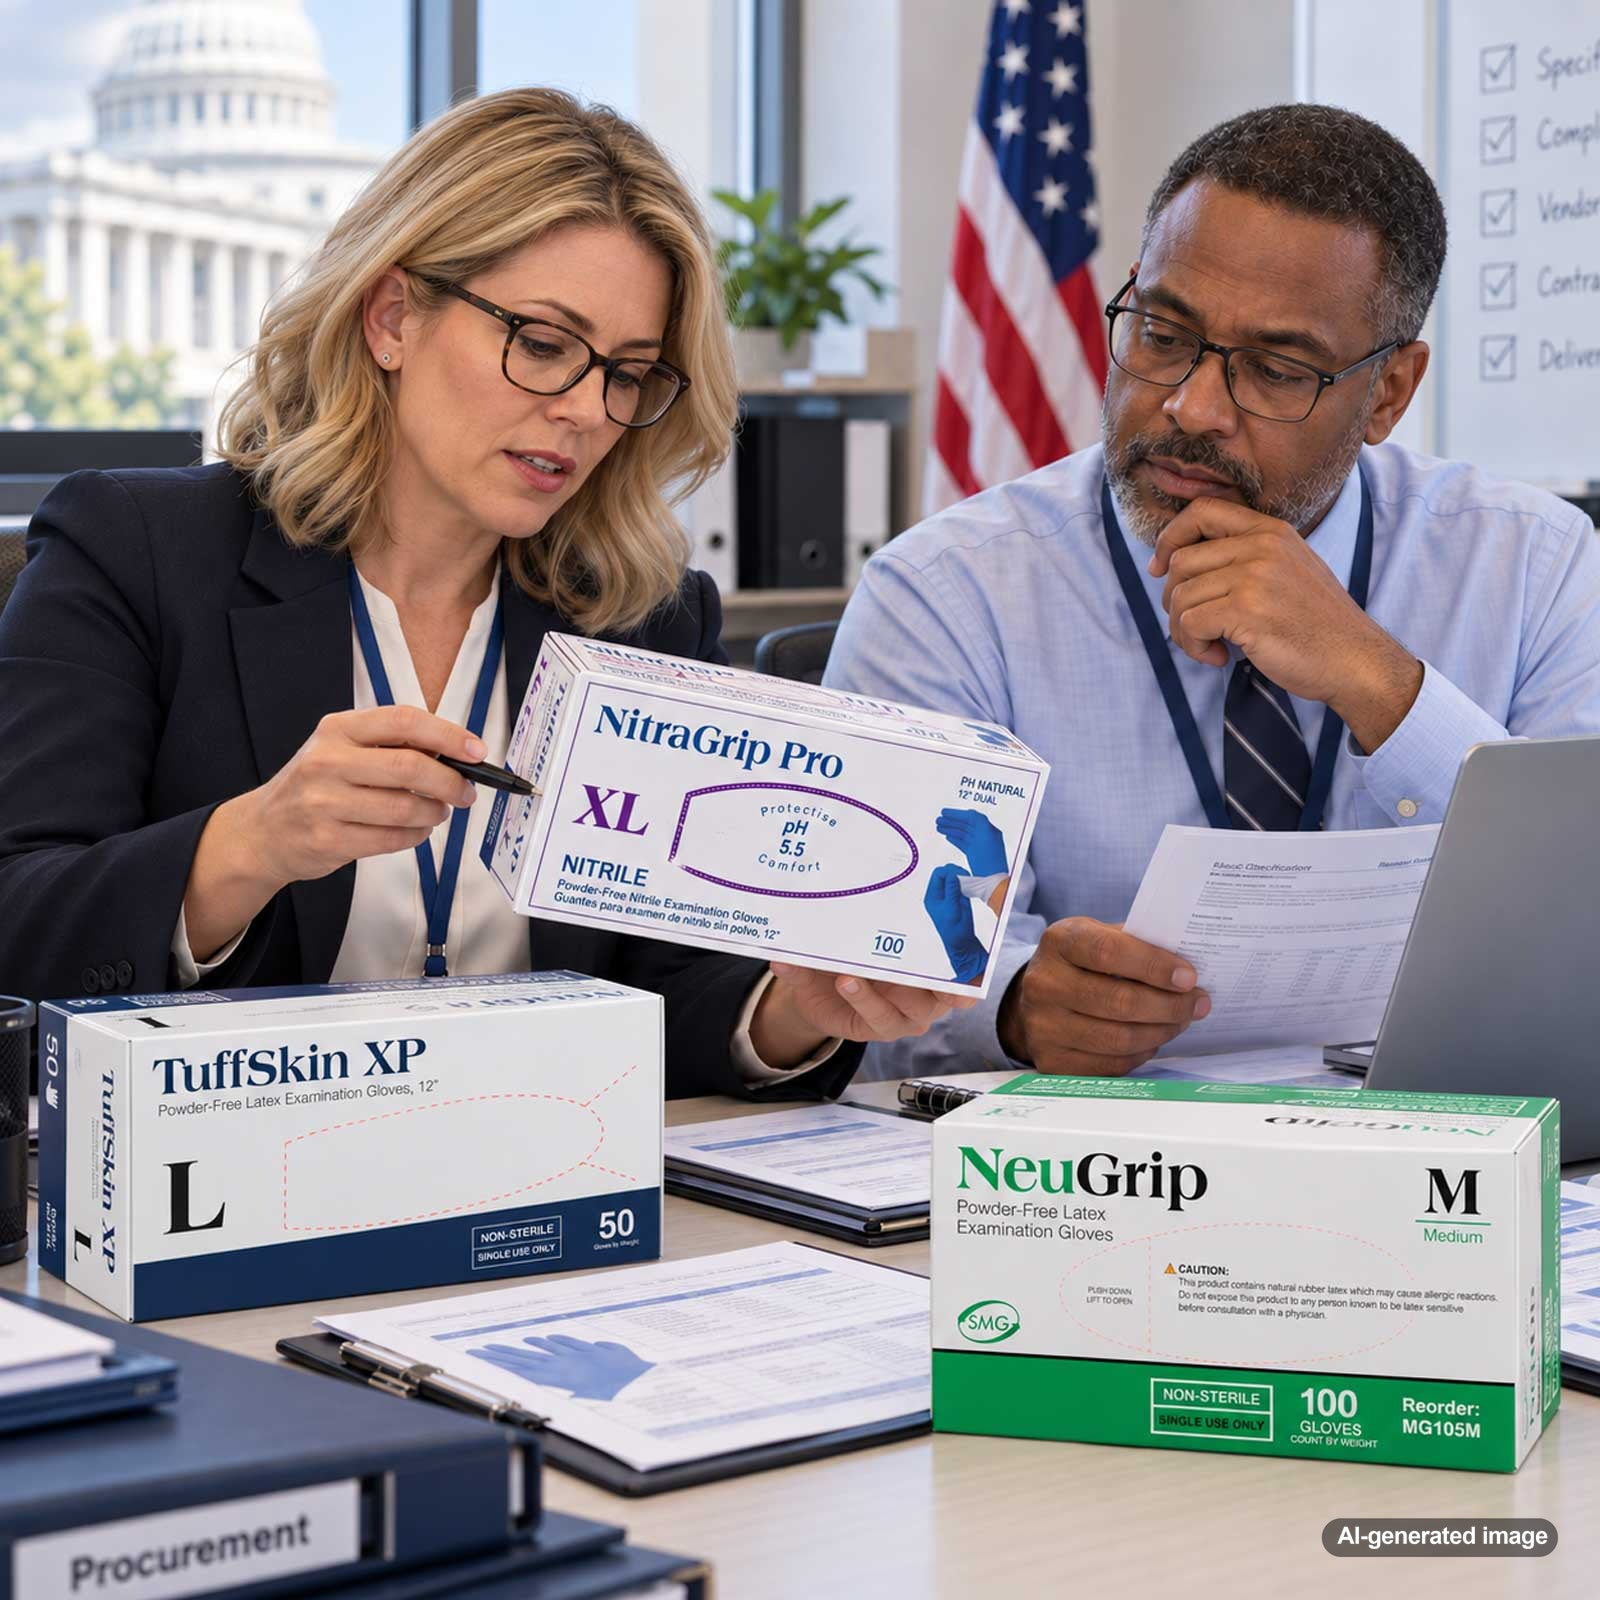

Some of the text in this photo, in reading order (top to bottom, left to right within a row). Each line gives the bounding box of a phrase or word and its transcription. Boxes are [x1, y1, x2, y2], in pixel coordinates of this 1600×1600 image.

[594, 704, 843, 779] NitraGrip Pro
[960, 775, 1026, 799] PH NATURAL
[973, 792, 998, 806] DUAL
[572, 784, 649, 836] XL
[781, 820, 809, 836] pH
[779, 839, 805, 857] 5.5
[561, 854, 649, 887] NITRILE
[758, 853, 821, 873] Comfort
[557, 878, 769, 926] Powder-Free Nitrile Examination Gloves
[554, 891, 597, 909] Guantes
[599, 900, 623, 914] para
[625, 906, 665, 921] examen
[667, 911, 681, 923] de
[713, 920, 728, 932] sin
[729, 923, 761, 939] polvo,
[875, 935, 904, 954] 100
[152, 1038, 427, 1095] TuffSkin XP
[157, 1095, 243, 1117] Powder-Free
[246, 1092, 281, 1109] Latex
[285, 1087, 363, 1106] Examination
[366, 1082, 415, 1099] Gloves,
[100, 1069, 116, 1274] TuffSkin XP
[956, 1146, 1208, 1212] NeuGrip
[163, 1160, 226, 1236] L
[1424, 1168, 1482, 1215] M
[957, 1199, 1105, 1221] Powder-Free Latex
[480, 1223, 555, 1243] NON-STERILE
[599, 1208, 635, 1240] 50
[957, 1220, 1113, 1241] Examination Gloves
[73, 1227, 93, 1263] L
[1424, 1228, 1483, 1243] Medium
[477, 1250, 511, 1262] SINGLE
[532, 1243, 556, 1254] ONLY
[1178, 1264, 1229, 1276] CAUTION:
[1178, 1277, 1195, 1287] This
[1198, 1280, 1229, 1289] product
[1231, 1281, 1265, 1291] contains
[1268, 1283, 1296, 1292] natural
[1298, 1285, 1325, 1293] rubber
[1328, 1285, 1347, 1295] latex
[1350, 1287, 1374, 1296] which
[1376, 1289, 1394, 1298] may
[1396, 1290, 1422, 1298] cause
[1424, 1290, 1454, 1301] allergic
[1178, 1291, 1190, 1299] Do
[1193, 1292, 1206, 1300] not
[1257, 1295, 1288, 1304] product
[1301, 1299, 1316, 1308] any
[1318, 1300, 1347, 1309] person
[1350, 1299, 1377, 1308] known
[1379, 1301, 1388, 1309] to
[1390, 1302, 1401, 1310] be
[1403, 1303, 1424, 1311] latex
[1178, 1303, 1205, 1312] before
[1259, 1306, 1275, 1316] with
[968, 1314, 1009, 1332] SMG
[1163, 1388, 1260, 1406] NON-STERILE
[1300, 1387, 1357, 1418] 100
[1402, 1397, 1480, 1416] Reorder:
[1159, 1415, 1265, 1431] SINGLE USE ONLY
[1300, 1420, 1362, 1436] GLOVES
[1402, 1418, 1480, 1438] MG105M
[1290, 1435, 1322, 1444] COUNT
[70, 1514, 310, 1593] Procurement
